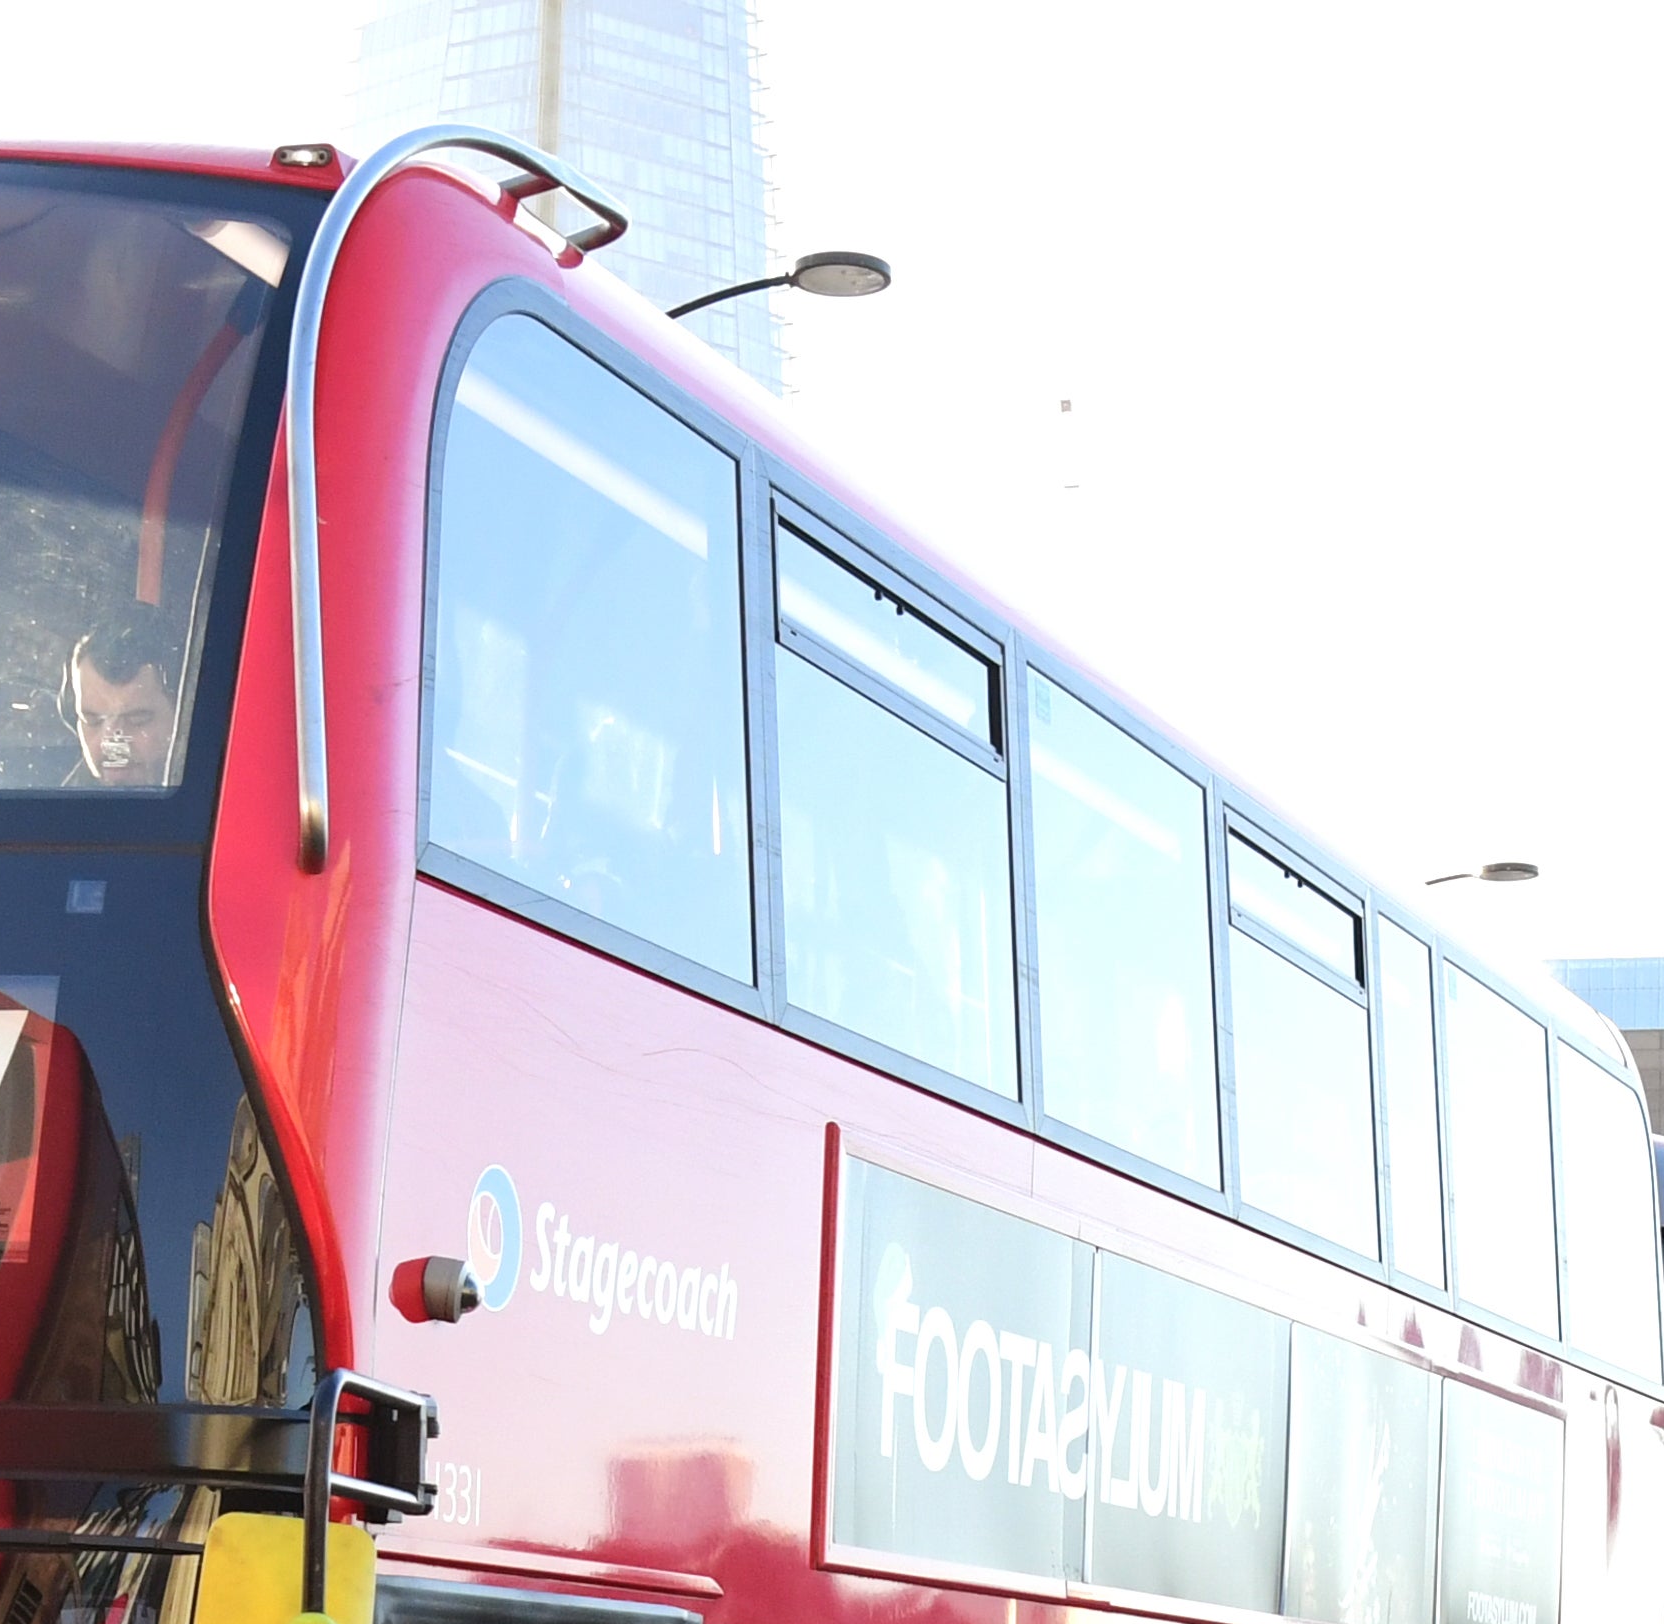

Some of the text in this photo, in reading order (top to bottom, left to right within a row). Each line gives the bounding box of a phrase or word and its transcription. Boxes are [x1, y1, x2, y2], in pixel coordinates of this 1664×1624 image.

[529, 1201, 738, 1340] Stagecoach
[878, 1300, 1208, 1524] FOOTASYLUM
[434, 1461, 482, 1527] 1331
